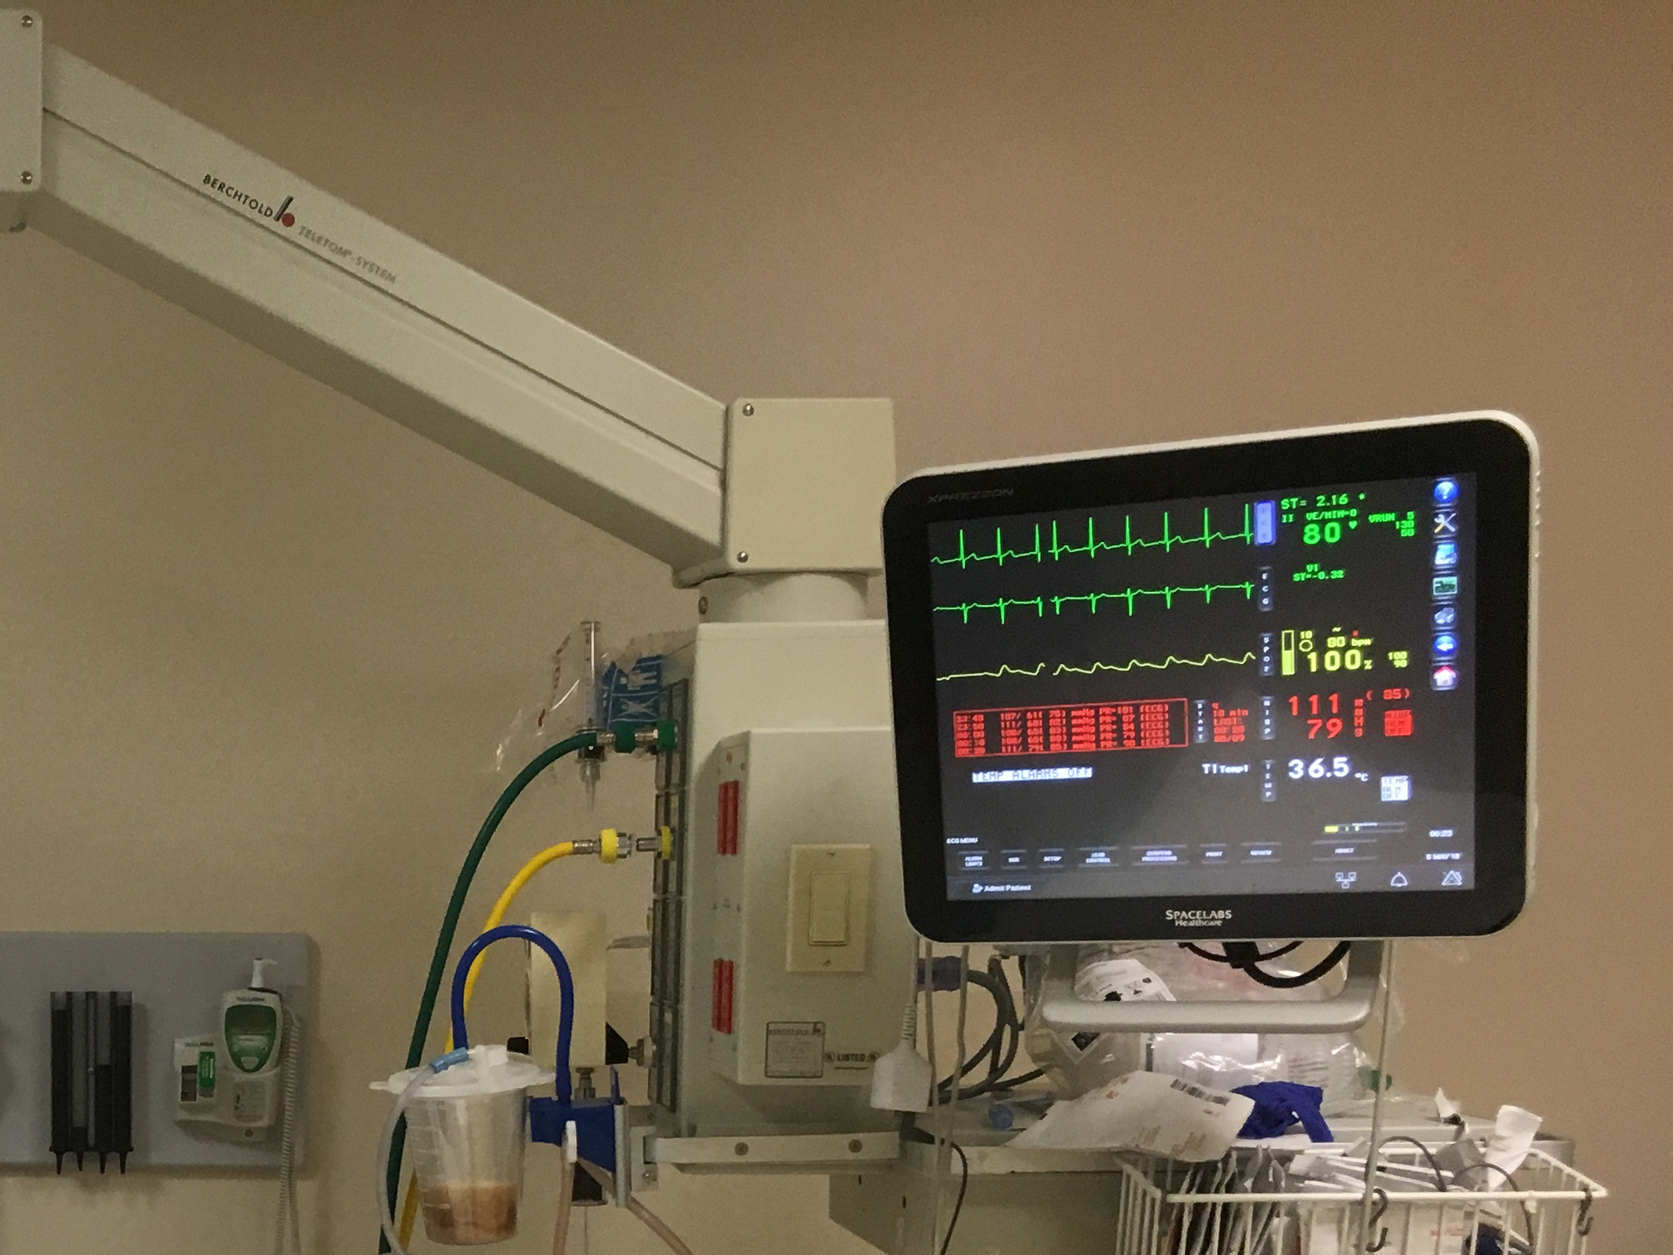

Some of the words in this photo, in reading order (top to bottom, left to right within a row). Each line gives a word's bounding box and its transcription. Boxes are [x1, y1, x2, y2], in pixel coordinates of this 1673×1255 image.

[202, 173, 274, 219] BERCHTOLD
[1302, 521, 1342, 545] 80
[1306, 649, 1362, 673] 100
[1288, 693, 1340, 716] 111
[1307, 717, 1343, 740] 79
[1288, 756, 1350, 779] 36.5
[1175, 918, 1223, 927] Healthcare
[836, 1053, 866, 1062] LISTED
